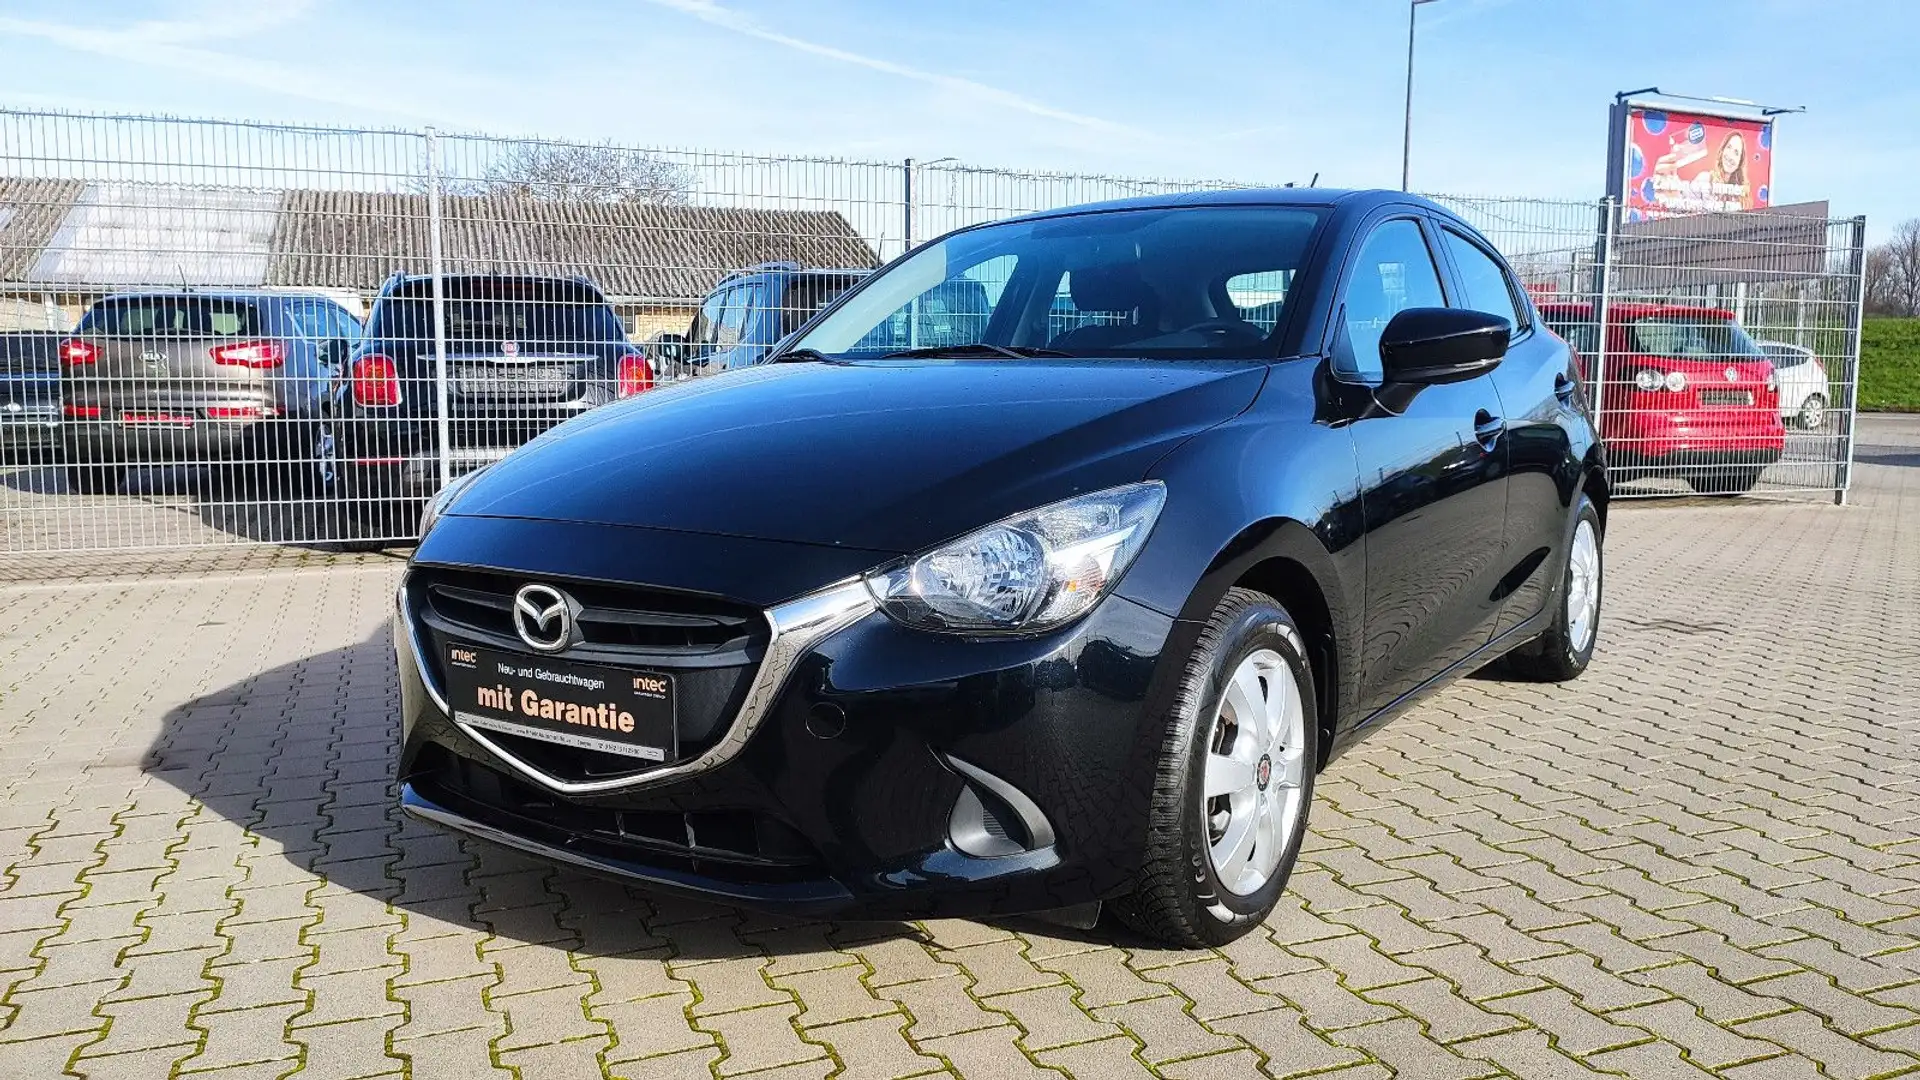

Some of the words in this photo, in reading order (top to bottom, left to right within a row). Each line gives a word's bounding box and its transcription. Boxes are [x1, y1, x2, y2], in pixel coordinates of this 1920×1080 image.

[451, 649, 477, 664] intec
[497, 662, 516, 676] Neu-
[517, 666, 533, 678] und
[535, 668, 605, 690] Gebrauchtwagen
[633, 677, 667, 693] intec
[477, 684, 514, 711] mit
[520, 690, 635, 733] Garantie
